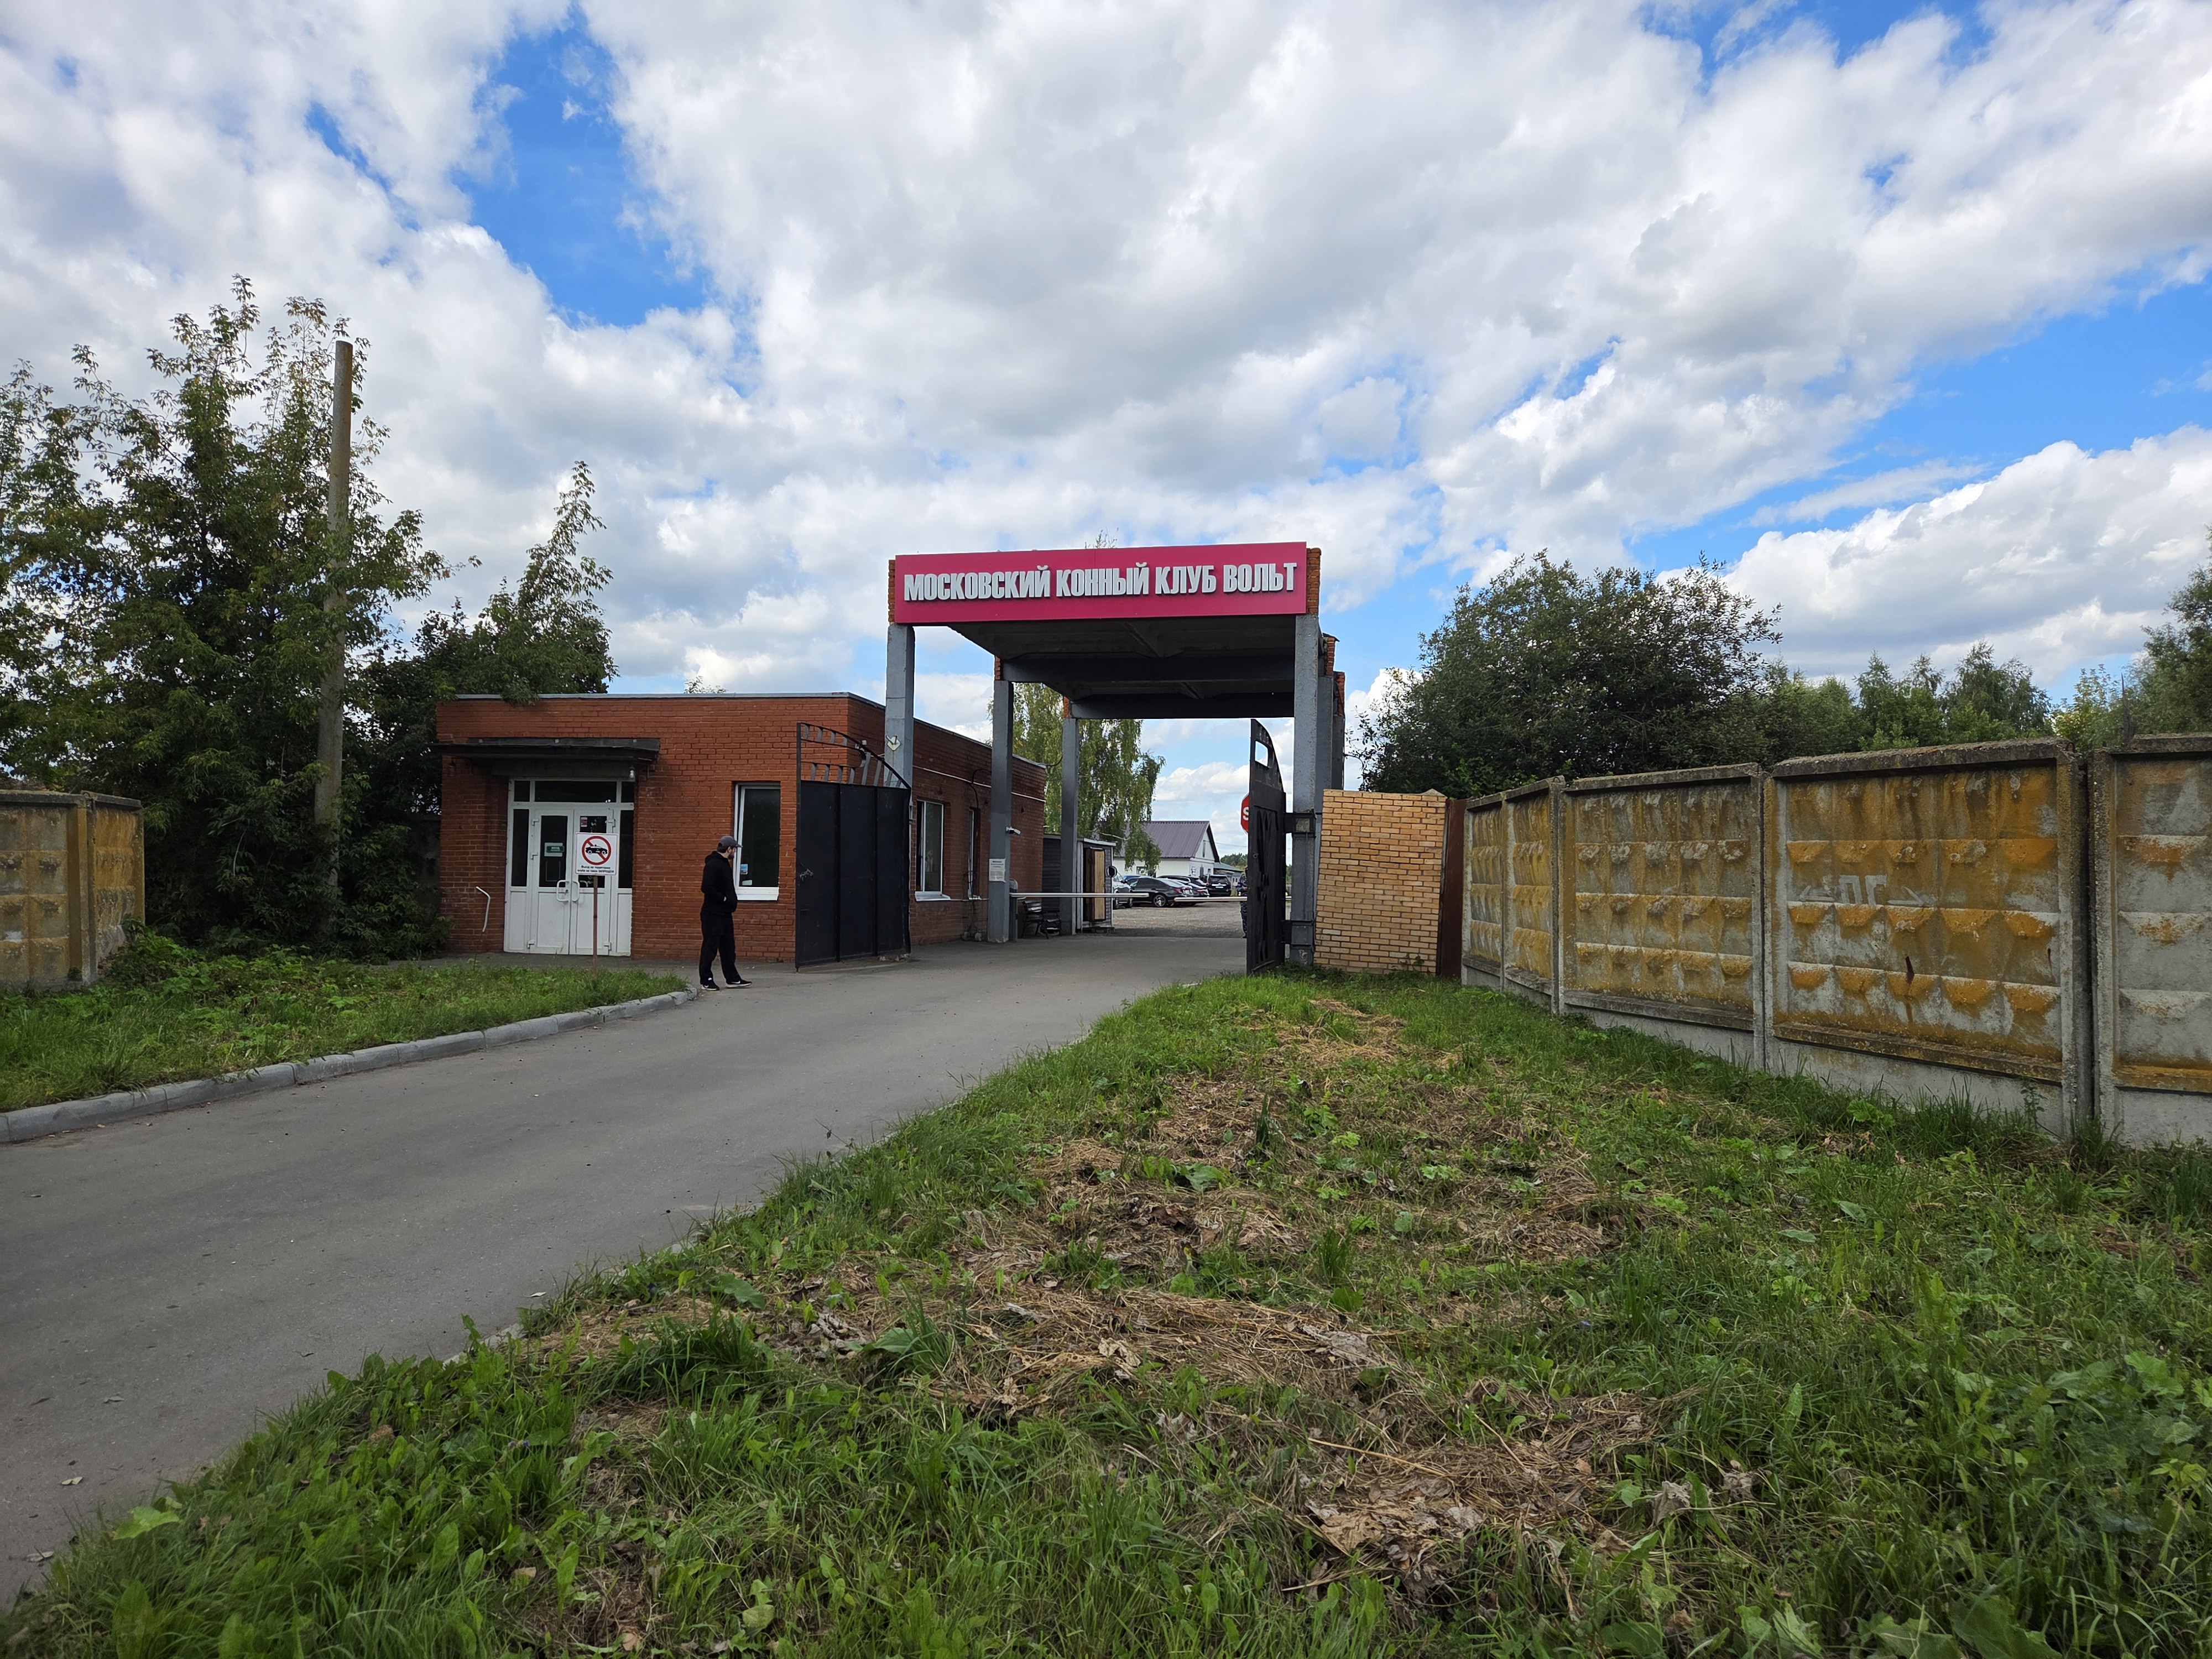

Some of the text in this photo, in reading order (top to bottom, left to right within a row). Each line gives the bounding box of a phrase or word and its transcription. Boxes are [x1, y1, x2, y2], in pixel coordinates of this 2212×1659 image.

[904, 561, 1297, 601] МОСКОВСКИЙ КОННЫЙ КЛУБ ВОЛЬТ
